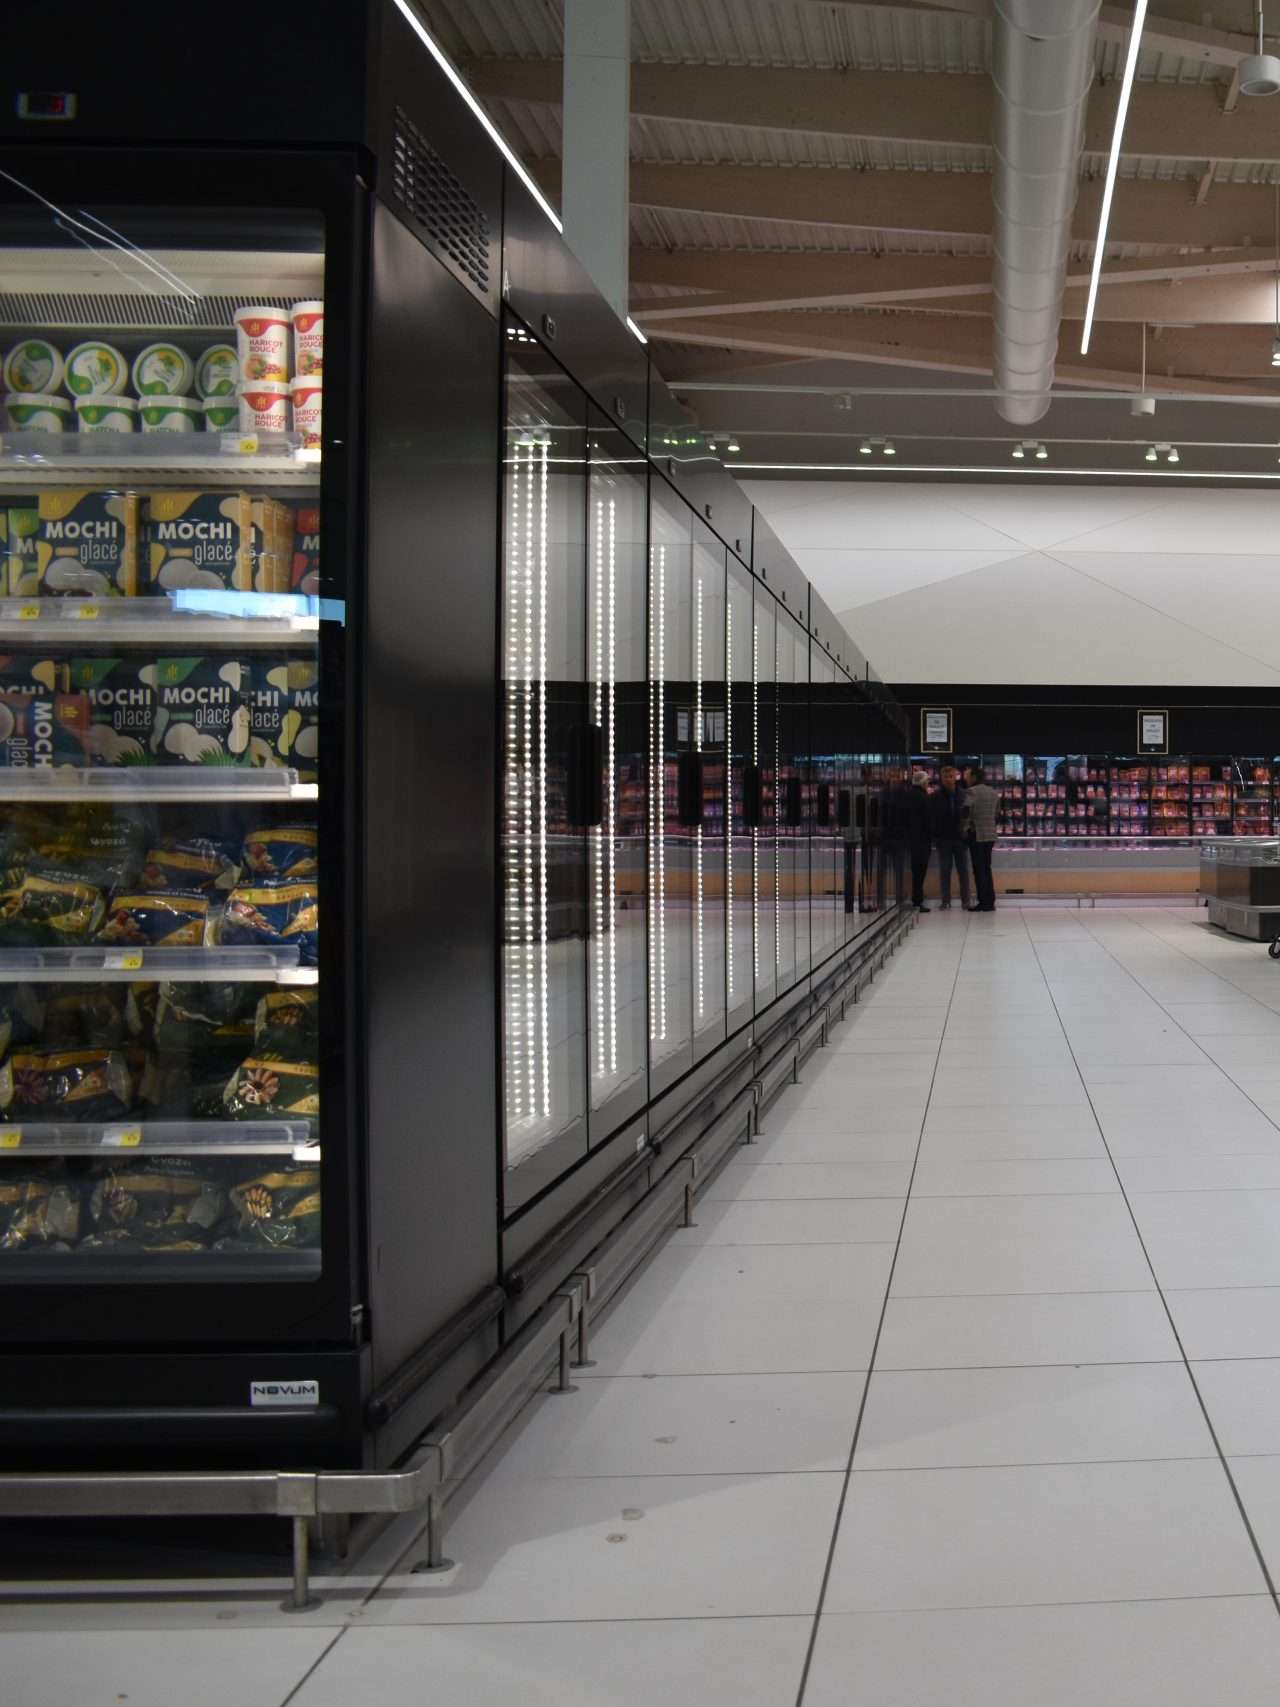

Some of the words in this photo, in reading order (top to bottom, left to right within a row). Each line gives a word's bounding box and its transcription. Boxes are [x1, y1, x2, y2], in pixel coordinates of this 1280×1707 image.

[45, 521, 118, 539] MOCHI
[158, 522, 232, 539] MOCHI
[80, 541, 118, 564] glacé
[194, 542, 233, 565] glacé
[163, 687, 230, 704] MOCHI
[114, 706, 151, 729] glacé
[195, 705, 230, 728] glacé
[253, 1385, 316, 1395] NOVUM
